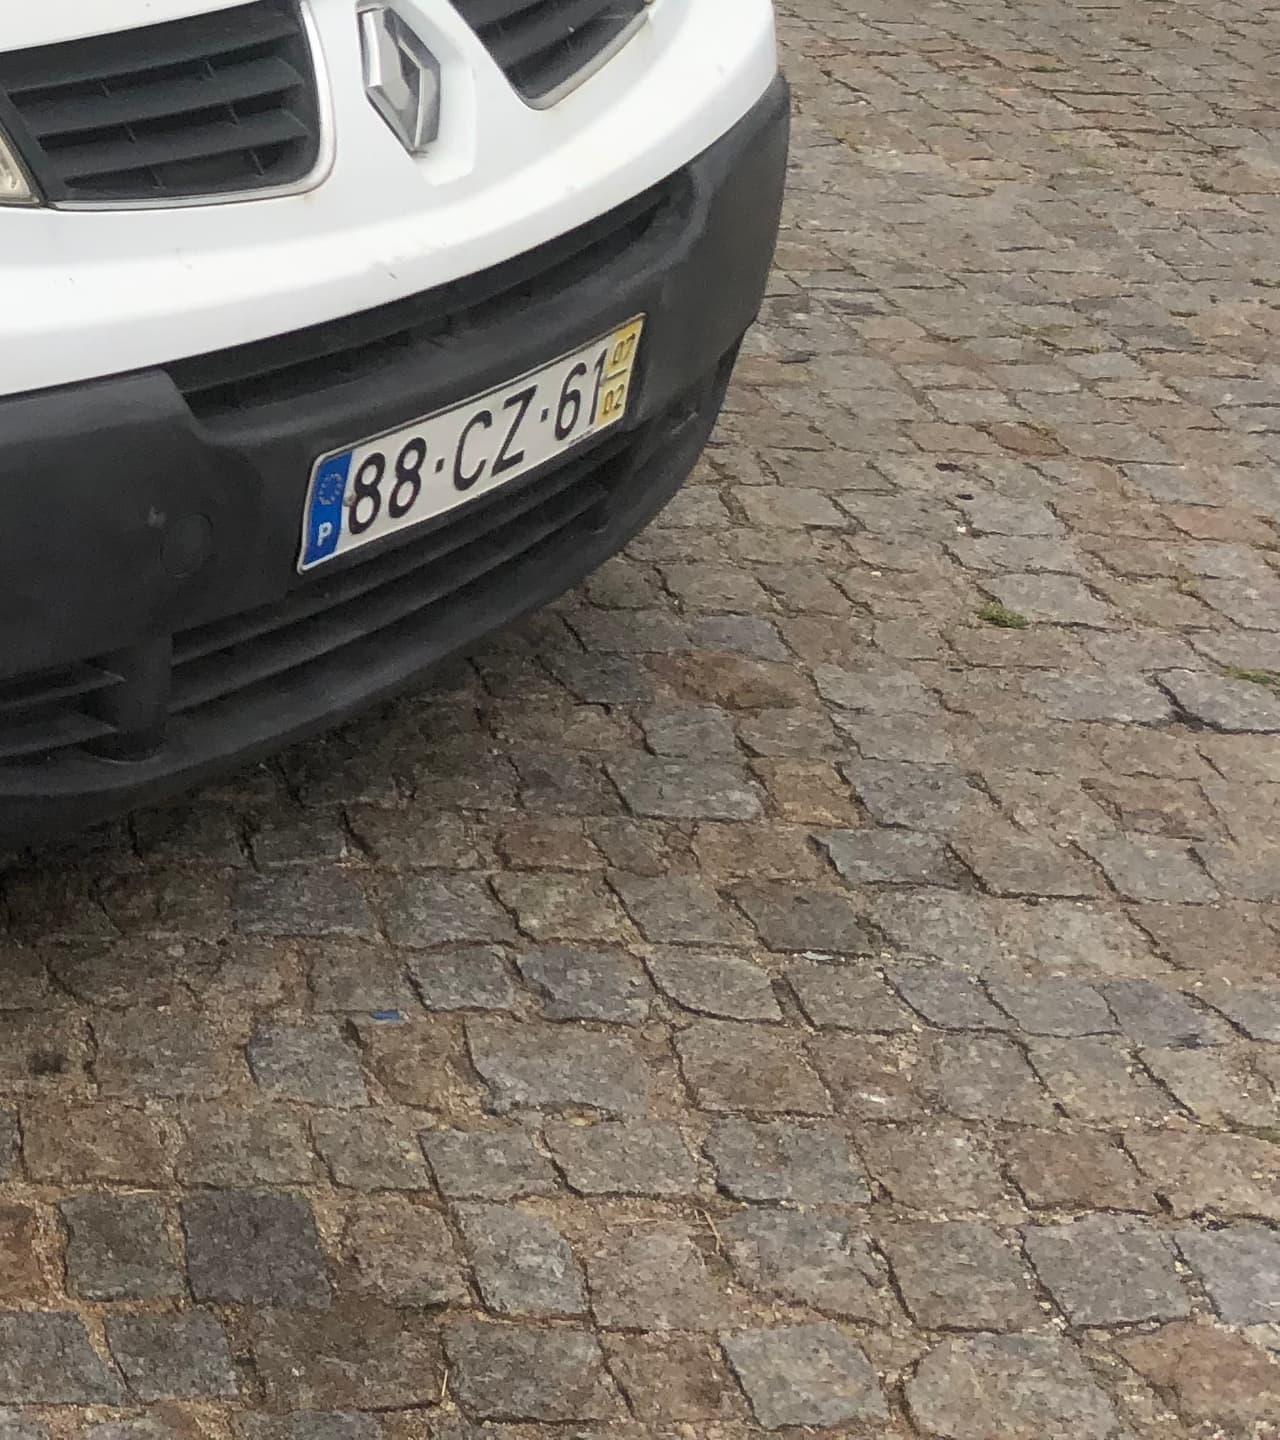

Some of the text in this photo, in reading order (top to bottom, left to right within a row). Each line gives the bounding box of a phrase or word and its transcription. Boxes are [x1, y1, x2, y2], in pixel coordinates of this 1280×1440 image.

[612, 333, 636, 364] 07
[601, 383, 625, 416] 02
[317, 521, 332, 546] P
